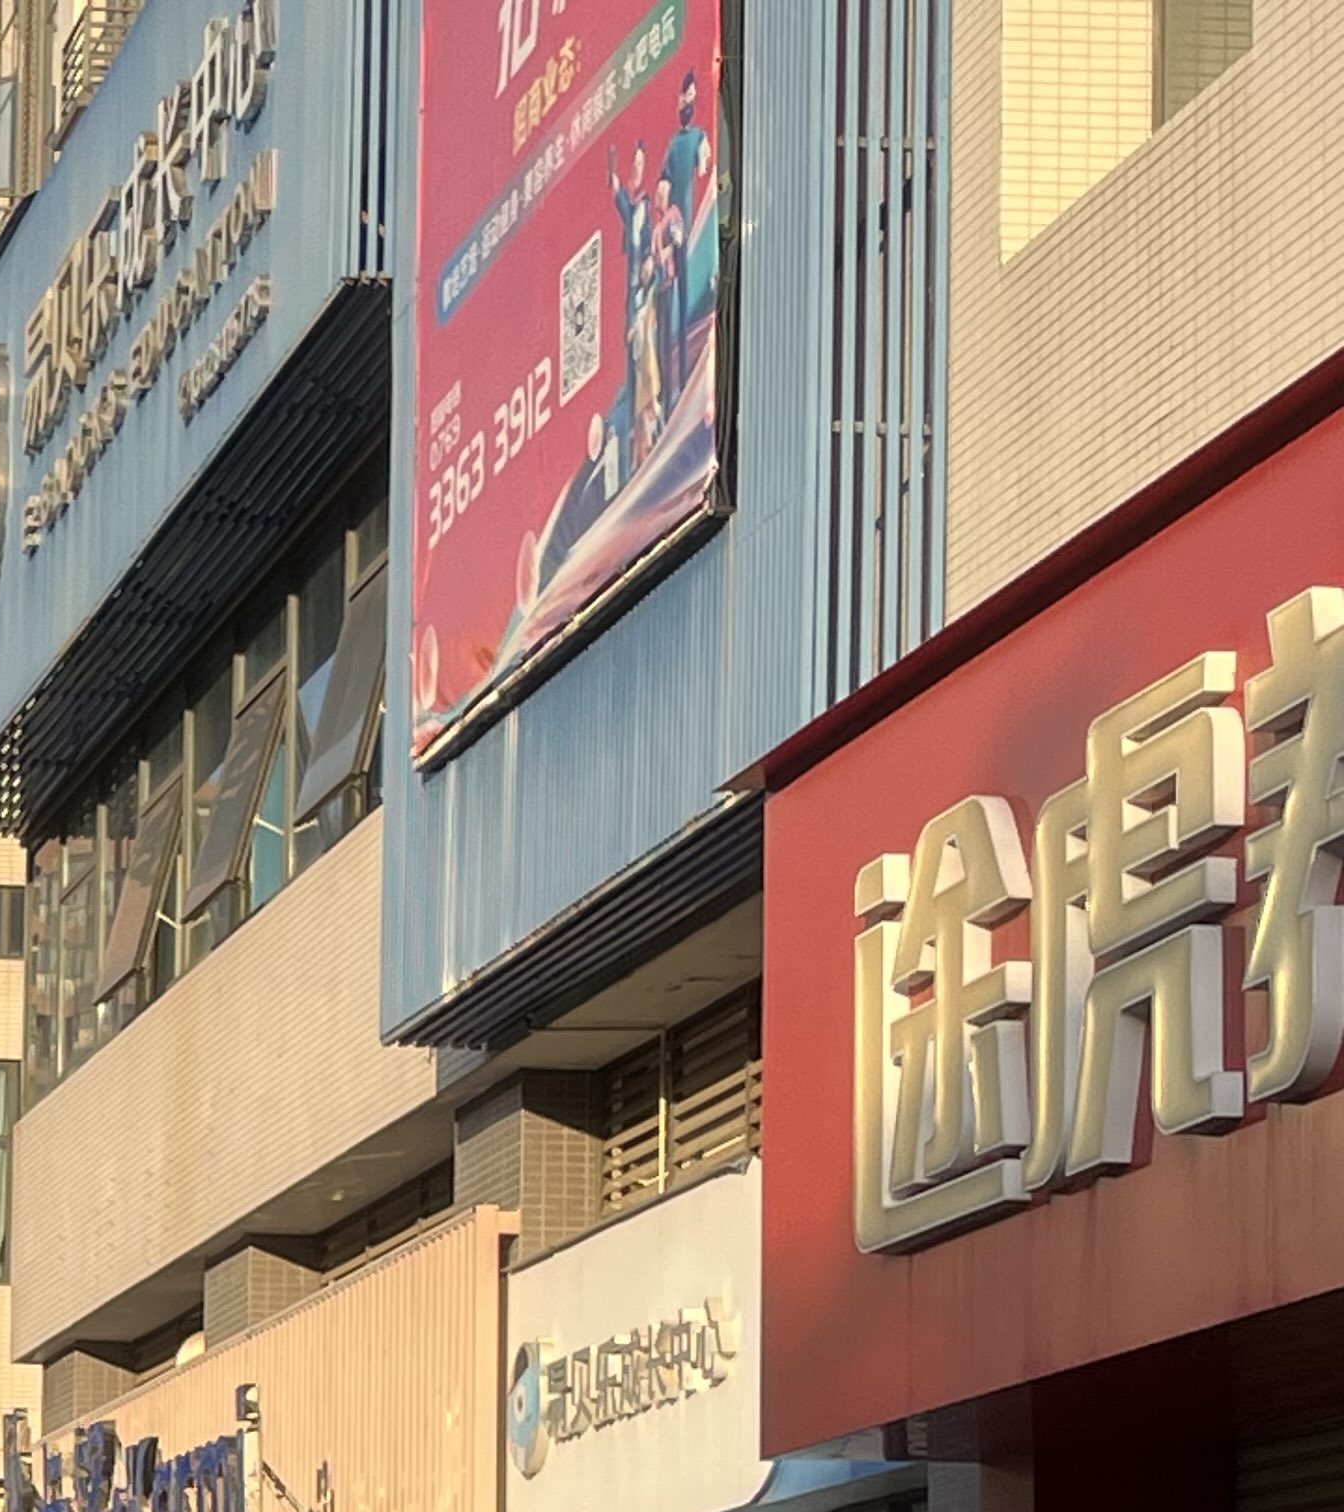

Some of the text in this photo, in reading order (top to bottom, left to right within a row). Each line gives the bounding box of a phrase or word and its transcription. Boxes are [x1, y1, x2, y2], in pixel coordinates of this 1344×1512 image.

[495, 0, 567, 98] 10
[428, 430, 485, 551] 3363
[493, 355, 552, 477] 3912
